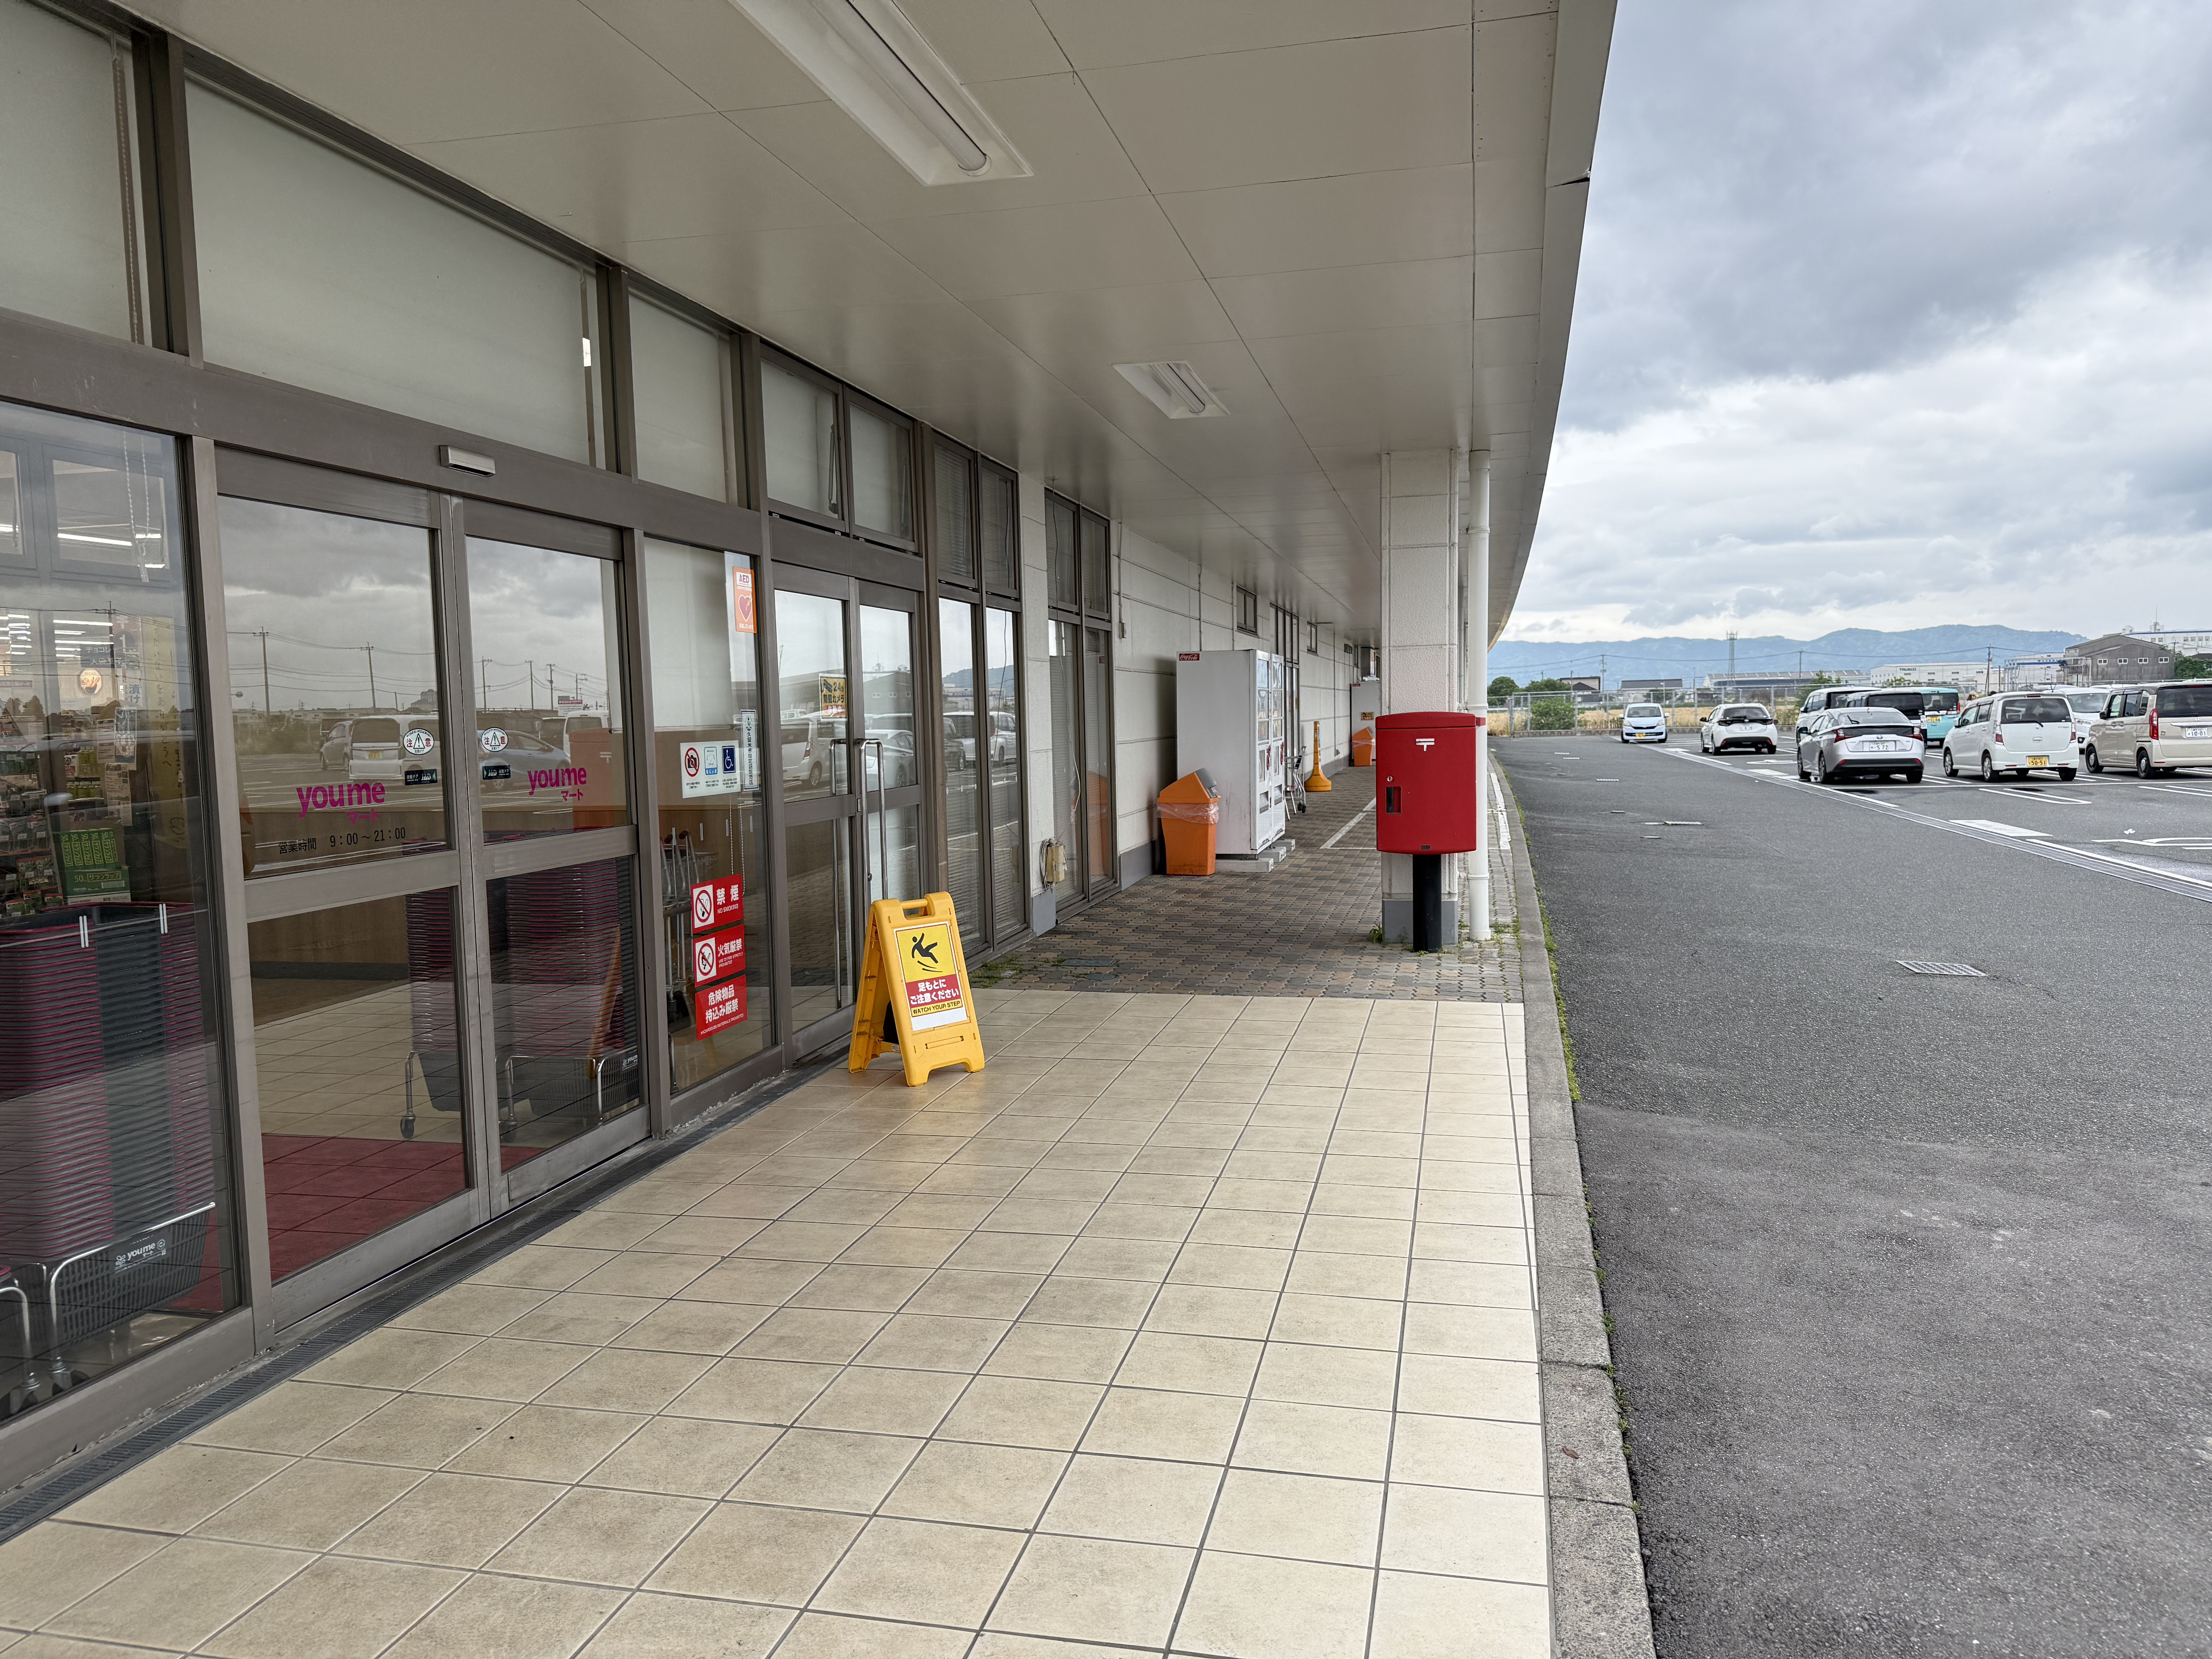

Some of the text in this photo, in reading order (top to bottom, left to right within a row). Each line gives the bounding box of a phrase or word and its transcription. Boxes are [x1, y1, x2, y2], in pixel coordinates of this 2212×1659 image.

[739, 574, 749, 583] AED
[834, 682, 843, 692] 24h
[824, 694, 844, 703] 防犯カメラ
[527, 767, 587, 795] youme
[296, 782, 385, 819] youme
[561, 788, 583, 802] マート
[347, 808, 380, 825] マート
[278, 838, 316, 854] 営業時間
[716, 884, 739, 905] 禁煙
[723, 903, 738, 912] SMOKING
[718, 938, 742, 957] 火気厳禁
[918, 979, 947, 992] 足もとに
[708, 984, 735, 1006] 危険物品
[910, 988, 959, 1005] ご注意ください
[706, 998, 738, 1024] 持込み厳禁
[127, 1243, 156, 1261] youme
